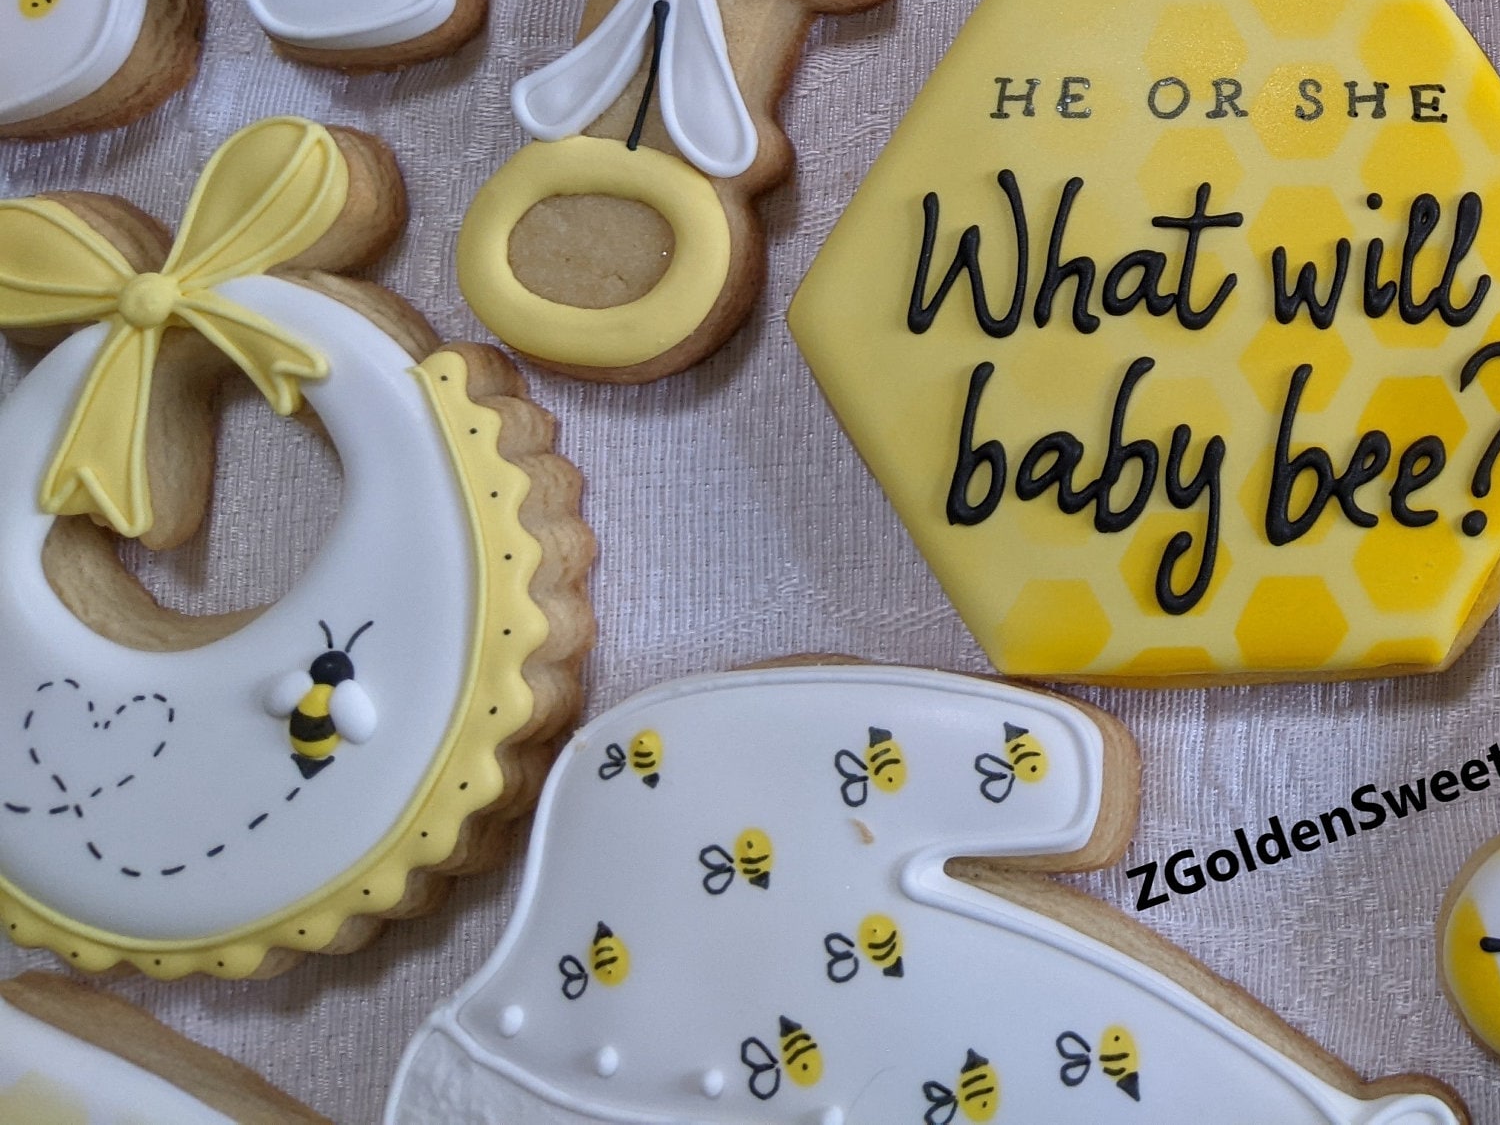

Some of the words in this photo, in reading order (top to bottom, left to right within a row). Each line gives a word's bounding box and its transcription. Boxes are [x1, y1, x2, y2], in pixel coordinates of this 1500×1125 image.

[988, 75, 1092, 120] HE
[1146, 75, 1250, 121] OR
[1293, 77, 1449, 124] SHE
[905, 168, 1244, 339] What
[1271, 191, 1492, 331] will
[945, 356, 1226, 616] baby
